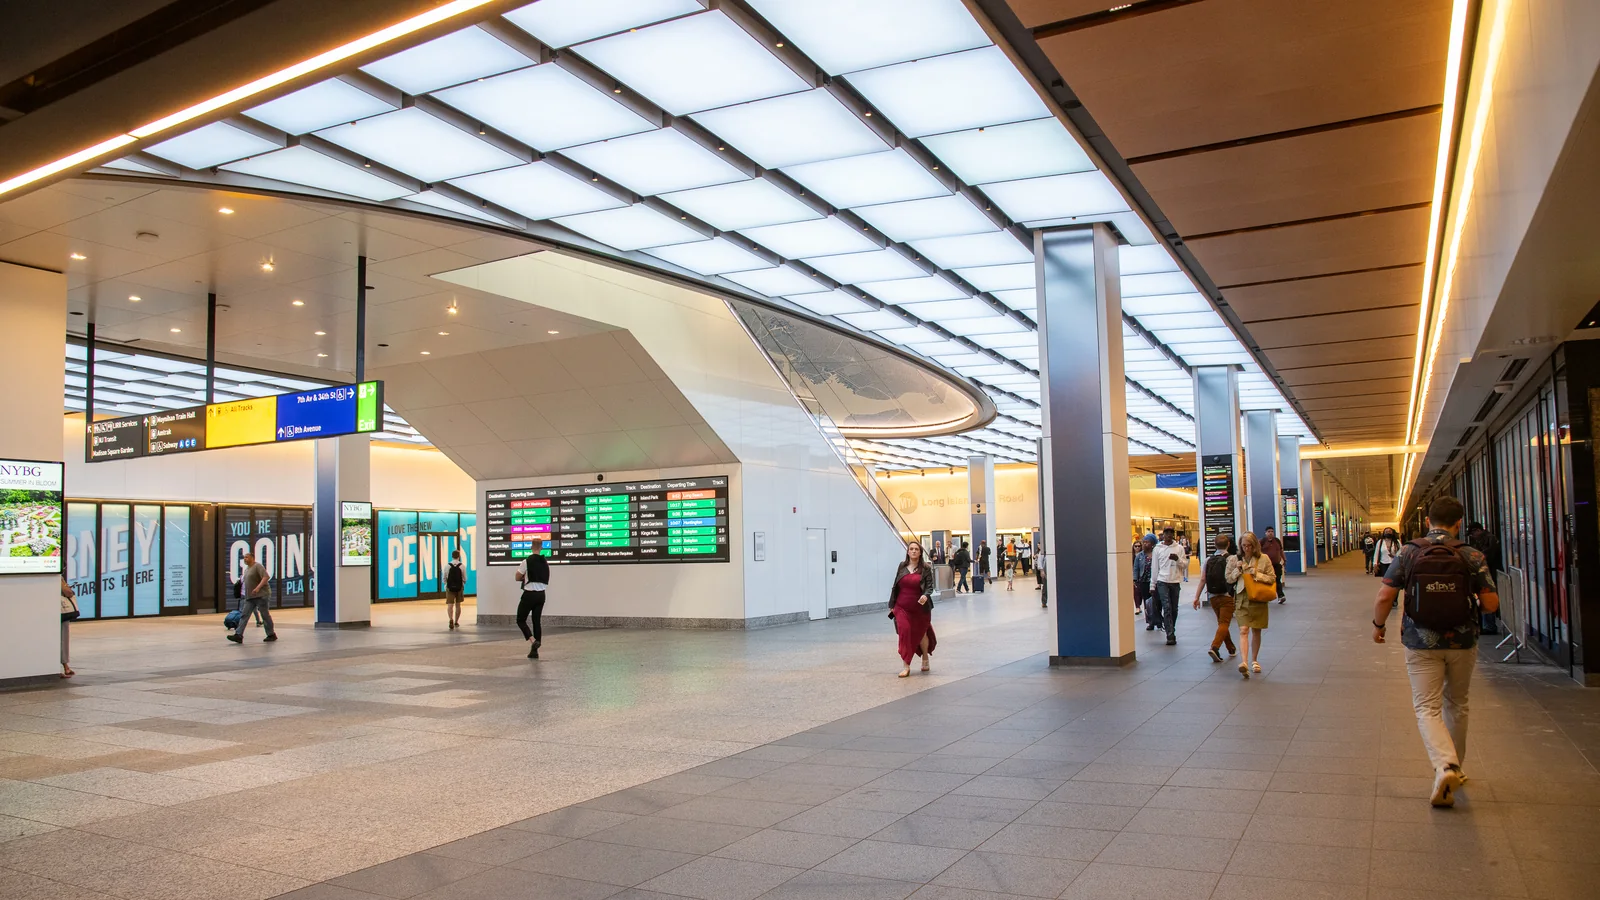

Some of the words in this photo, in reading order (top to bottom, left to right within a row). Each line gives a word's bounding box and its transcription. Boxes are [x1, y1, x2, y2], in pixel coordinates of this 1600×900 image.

[297, 396, 305, 404] 7th
[318, 393, 329, 401] 34th
[238, 404, 253, 412] Tracks
[157, 415, 175, 423] Moynihan
[359, 419, 375, 430] Exit
[157, 428, 172, 436] Amtrak
[303, 425, 322, 433] Avenue
[163, 441, 178, 449] Subway
[108, 448, 120, 456] Square
[0, 465, 41, 477] NYBG
[922, 498, 944, 508] Long
[999, 493, 1023, 503] Road
[343, 504, 362, 512] NYBG
[231, 519, 271, 537] YOU'RE
[391, 526, 405, 534] LOVE
[407, 523, 418, 532] THE
[419, 521, 432, 531] NEW
[230, 533, 315, 585] GOIN
[121, 569, 154, 587] HERE
